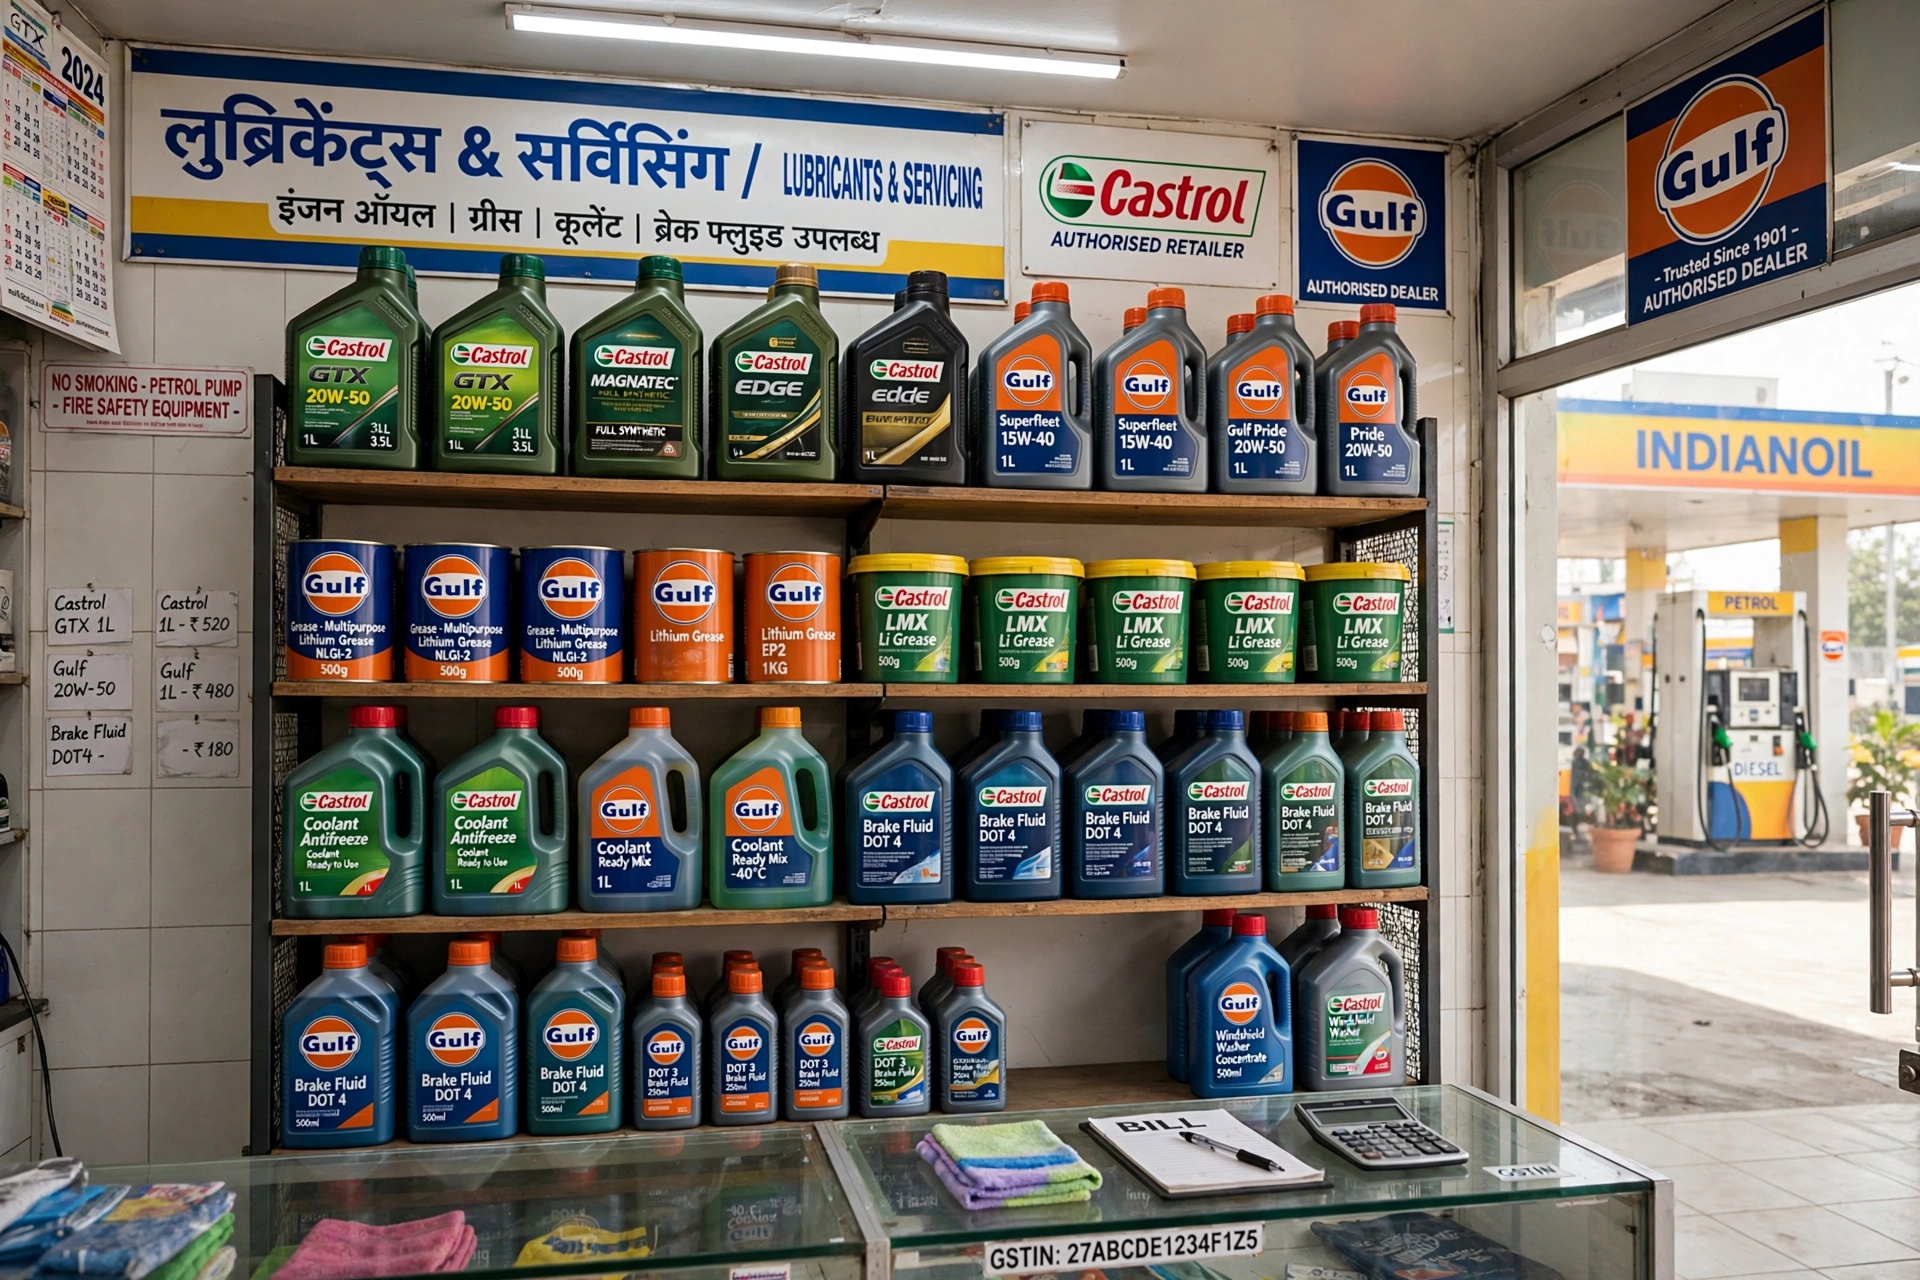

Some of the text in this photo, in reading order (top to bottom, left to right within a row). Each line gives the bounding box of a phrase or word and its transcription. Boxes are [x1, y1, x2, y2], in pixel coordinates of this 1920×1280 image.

[11, 13, 44, 51] GTX
[62, 47, 104, 107] 2024
[160, 94, 441, 189] लुब्रिकेंट्स
[458, 126, 503, 177] &
[516, 118, 730, 191] सर्विसिंग
[742, 143, 762, 199] /
[784, 153, 882, 202] LUBRICANTS
[888, 167, 898, 203] &
[904, 162, 982, 209] SERVICING
[1663, 117, 1775, 200] Gulf
[1100, 169, 1248, 223] Castrol
[1327, 194, 1417, 231] Gulf
[276, 188, 344, 225] इंजन
[354, 193, 436, 228] ऑयल
[468, 199, 522, 232] ग्रीस
[554, 204, 623, 245] कूलेंट
[654, 210, 700, 242] ब्रेक
[707, 222, 784, 255] फ्लुइड
[792, 227, 880, 253] उपलब्ध
[1051, 231, 1244, 258] AUTHORISED RETAILER
[1663, 256, 1710, 283] Trusted
[1714, 243, 1752, 265] Since
[1754, 225, 1786, 250] 1901
[1644, 242, 1808, 313] AUTHORISED DEALER
[1307, 280, 1438, 301] AUTHORISED DEALER
[327, 339, 385, 358] Castrol
[613, 348, 669, 366] Castrol
[751, 354, 806, 370] Castrol
[308, 365, 372, 384] GTX
[888, 362, 938, 378] Castrol
[52, 374, 71, 391] NO
[75, 374, 137, 393] SMOKING
[150, 378, 201, 395] PETROL
[206, 379, 242, 397] PUMP
[591, 374, 675, 389] MAGNATEC
[735, 380, 803, 396] EDGE
[1006, 372, 1050, 389] Gulf
[306, 389, 370, 405] 20W-50
[1237, 383, 1280, 398] Gulf
[1348, 388, 1388, 403] Gulf
[63, 396, 93, 414] FIRE
[97, 398, 148, 416] SAFETY
[152, 400, 230, 420] EQUIPMENT
[1000, 414, 1060, 429] Superfleet
[596, 426, 616, 435] FULL
[1227, 423, 1287, 437] Gulf Pride
[1351, 426, 1384, 441] Pride
[371, 436, 392, 447] 3.5L
[1002, 431, 1054, 446] 15W-40
[1235, 440, 1285, 454] 20W-50
[1346, 444, 1392, 457] 20W-50
[1638, 431, 1873, 478] INDIANOIL
[1002, 455, 1015, 467] 1L
[1234, 462, 1247, 473] 1L
[1345, 465, 1357, 476] 1L
[305, 574, 365, 593] Gulf
[769, 584, 822, 601] Gulf
[895, 589, 947, 606] Castrol
[55, 594, 106, 611] Castrol
[161, 595, 208, 610] Castrol
[1725, 596, 1778, 610] PETROL
[55, 616, 114, 634] GTX 1L
[886, 614, 929, 630] LMX
[300, 634, 374, 646] Lithium Grease
[762, 627, 835, 640] Lithium Grease
[879, 633, 937, 646] Li Grease
[316, 648, 352, 659] NLGI-2
[763, 643, 786, 656] EP2
[54, 660, 88, 677] Gulf
[763, 661, 788, 674] 1KG
[879, 656, 900, 668] 500g
[161, 662, 196, 680] Gulf
[322, 664, 348, 678] 500g
[54, 681, 115, 698] 20W-50
[51, 723, 126, 741] Brake Fluid
[52, 748, 92, 765] DOT4
[1734, 762, 1782, 776] DIESEL
[1204, 784, 1245, 798] Castrol
[318, 794, 368, 808] Castrol
[882, 794, 929, 809] Castrol
[602, 803, 647, 816] Gulf
[1189, 806, 1248, 819] Brake Fluid
[304, 816, 359, 830] Coolant
[864, 819, 933, 833] Brake Fluid
[1189, 822, 1222, 833] DOT 4
[300, 832, 368, 846] Antifreeze
[864, 835, 901, 847] DOT 4
[597, 840, 651, 854] Coolant
[599, 855, 651, 870] Ready Mix
[299, 881, 311, 891] 1L
[598, 876, 612, 888] 1L
[1221, 998, 1257, 1009] Gulf
[1343, 996, 1381, 1010] Castrol
[303, 1035, 356, 1051] Gulf
[801, 1033, 832, 1045] Gulf
[887, 1040, 917, 1050] Castrol
[800, 1059, 828, 1069] DOT 3
[296, 1075, 366, 1091] Brake Fluid
[309, 1093, 346, 1106] DOT 4
[1116, 1118, 1206, 1132] BILL
[991, 1230, 1257, 1269] GSTIN: 27ABCDE1234F1Z5
